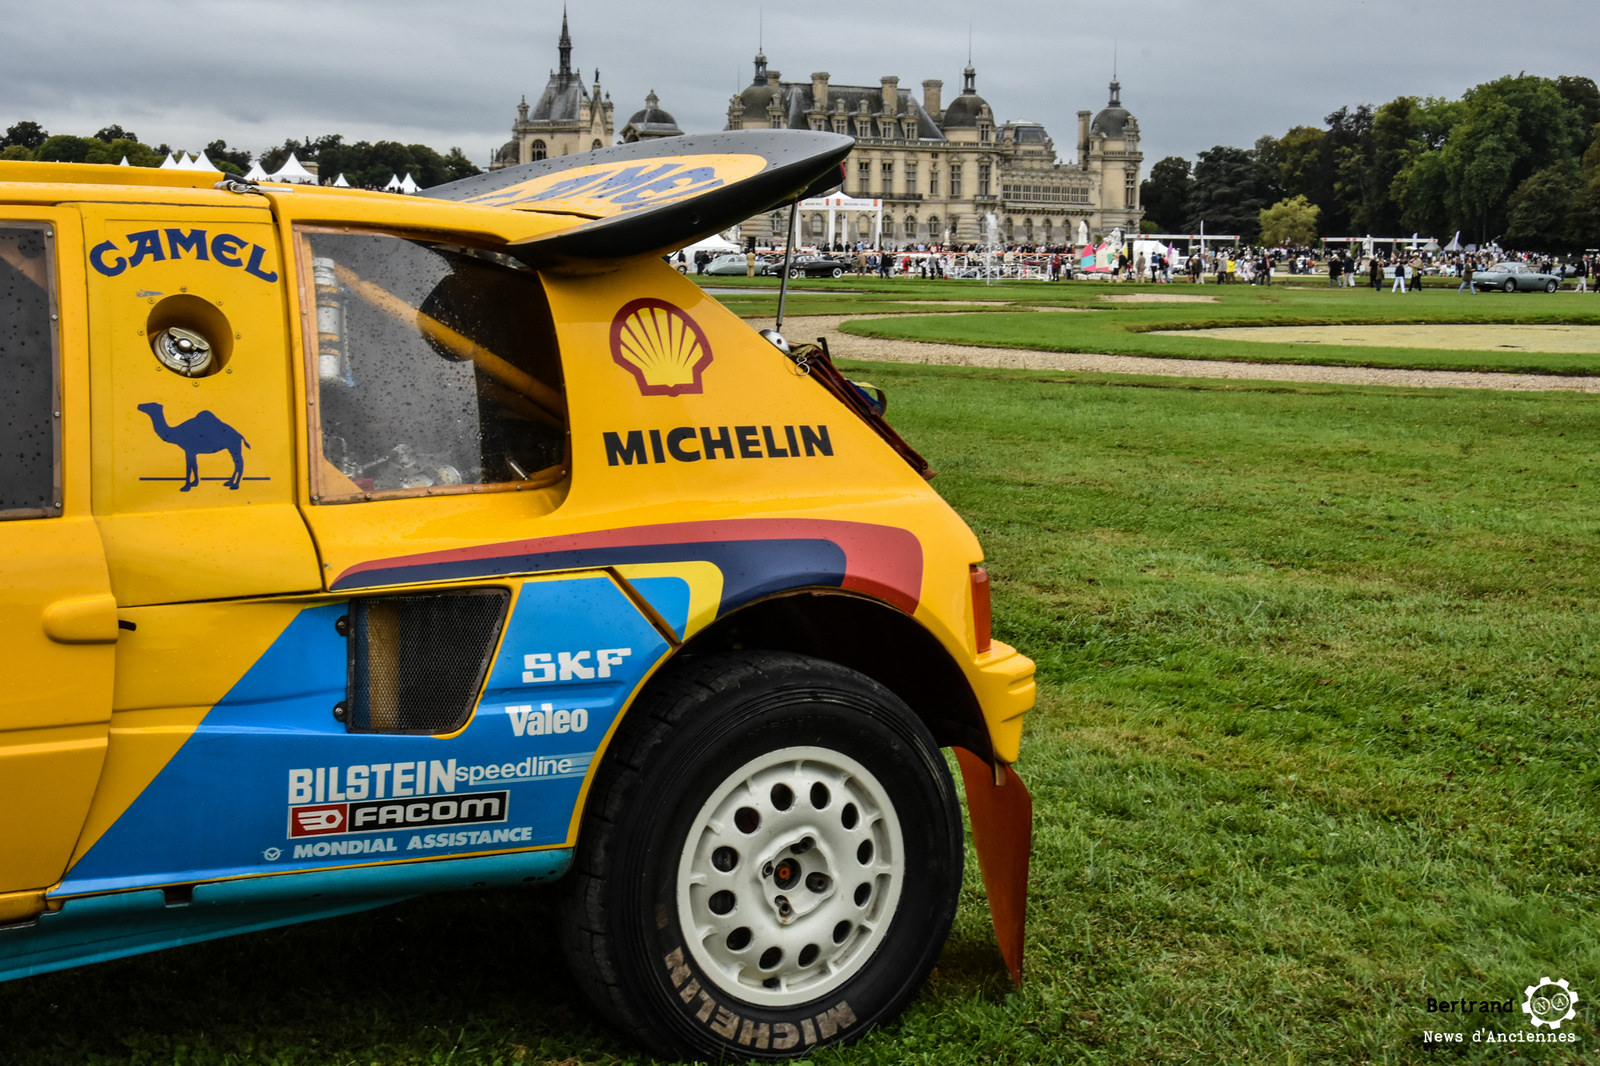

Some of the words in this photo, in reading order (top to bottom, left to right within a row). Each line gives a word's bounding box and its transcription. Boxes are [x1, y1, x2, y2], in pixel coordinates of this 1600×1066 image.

[89, 228, 279, 283] CAMEL
[602, 424, 834, 467] MICHELIN
[521, 647, 632, 683] SKF
[505, 703, 589, 737] Valeo
[288, 758, 457, 805] BILSTEIN
[455, 755, 573, 786] speedline
[354, 794, 500, 827] FACOM
[293, 837, 398, 859] MONDIAL
[406, 826, 533, 850] ASSISTANCE
[664, 946, 858, 1050] MICHELIN
